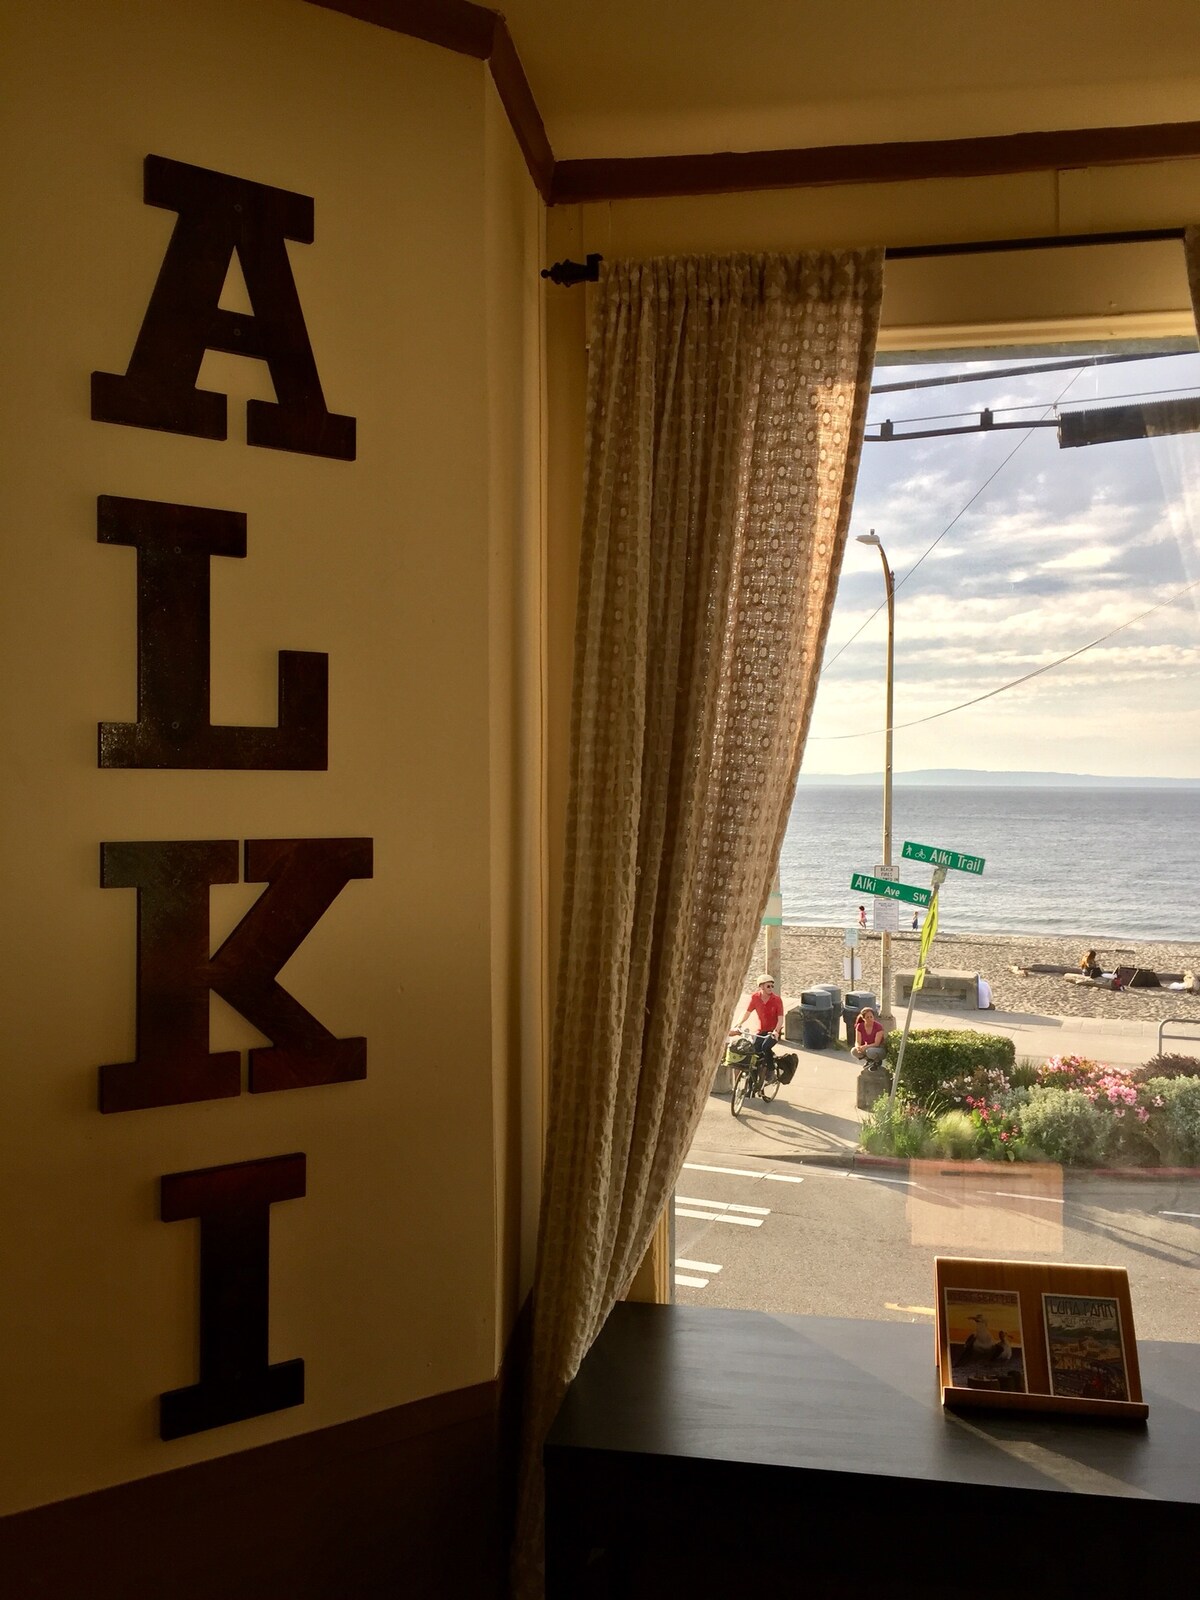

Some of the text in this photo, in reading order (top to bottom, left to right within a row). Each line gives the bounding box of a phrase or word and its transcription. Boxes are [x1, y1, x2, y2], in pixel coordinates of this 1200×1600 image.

[91, 154, 373, 1441] ALKI
[929, 849, 982, 872] Alki Trail
[854, 876, 877, 892] Alki
[883, 886, 900, 897] Ave
[912, 892, 928, 903] SW
